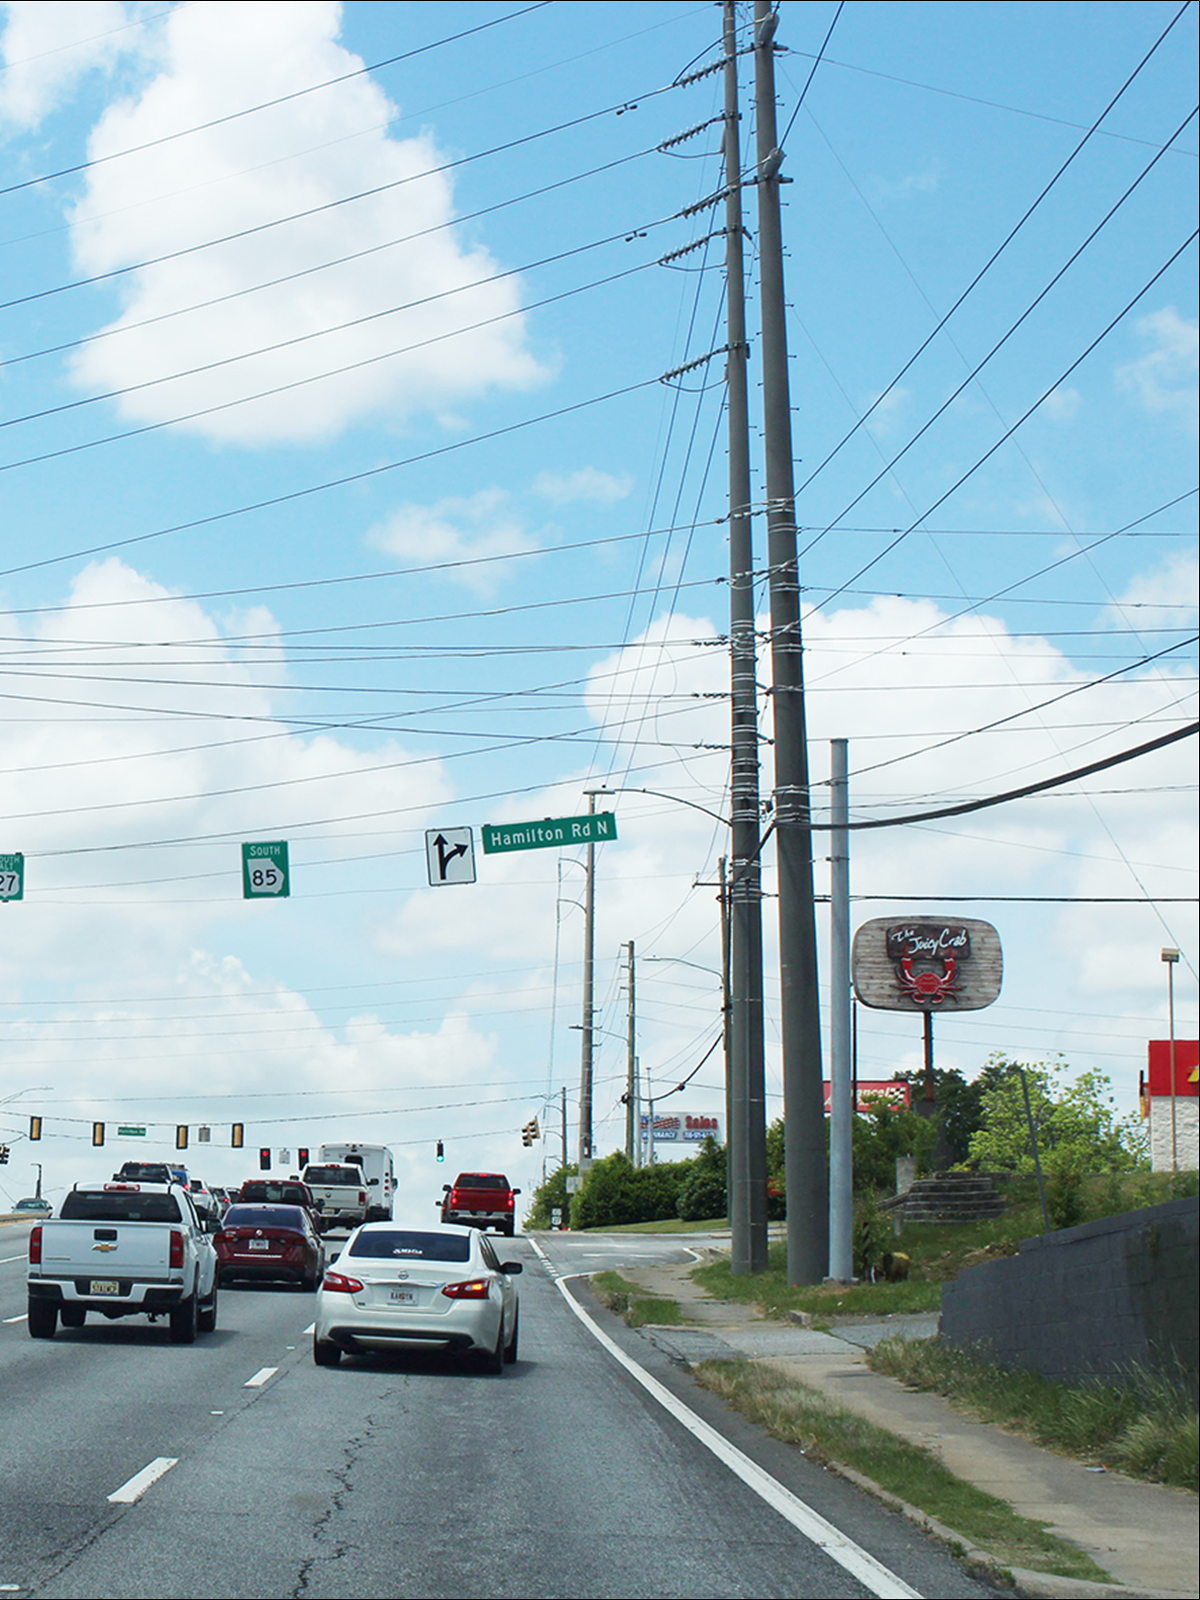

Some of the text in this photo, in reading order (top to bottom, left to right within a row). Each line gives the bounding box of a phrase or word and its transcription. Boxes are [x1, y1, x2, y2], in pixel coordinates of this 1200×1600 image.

[491, 820, 608, 846] Hamilton Rd N
[250, 845, 280, 856] SOUTH
[252, 868, 277, 887] 85
[908, 928, 967, 956] Juicy Crab
[685, 1115, 718, 1130] Sales
